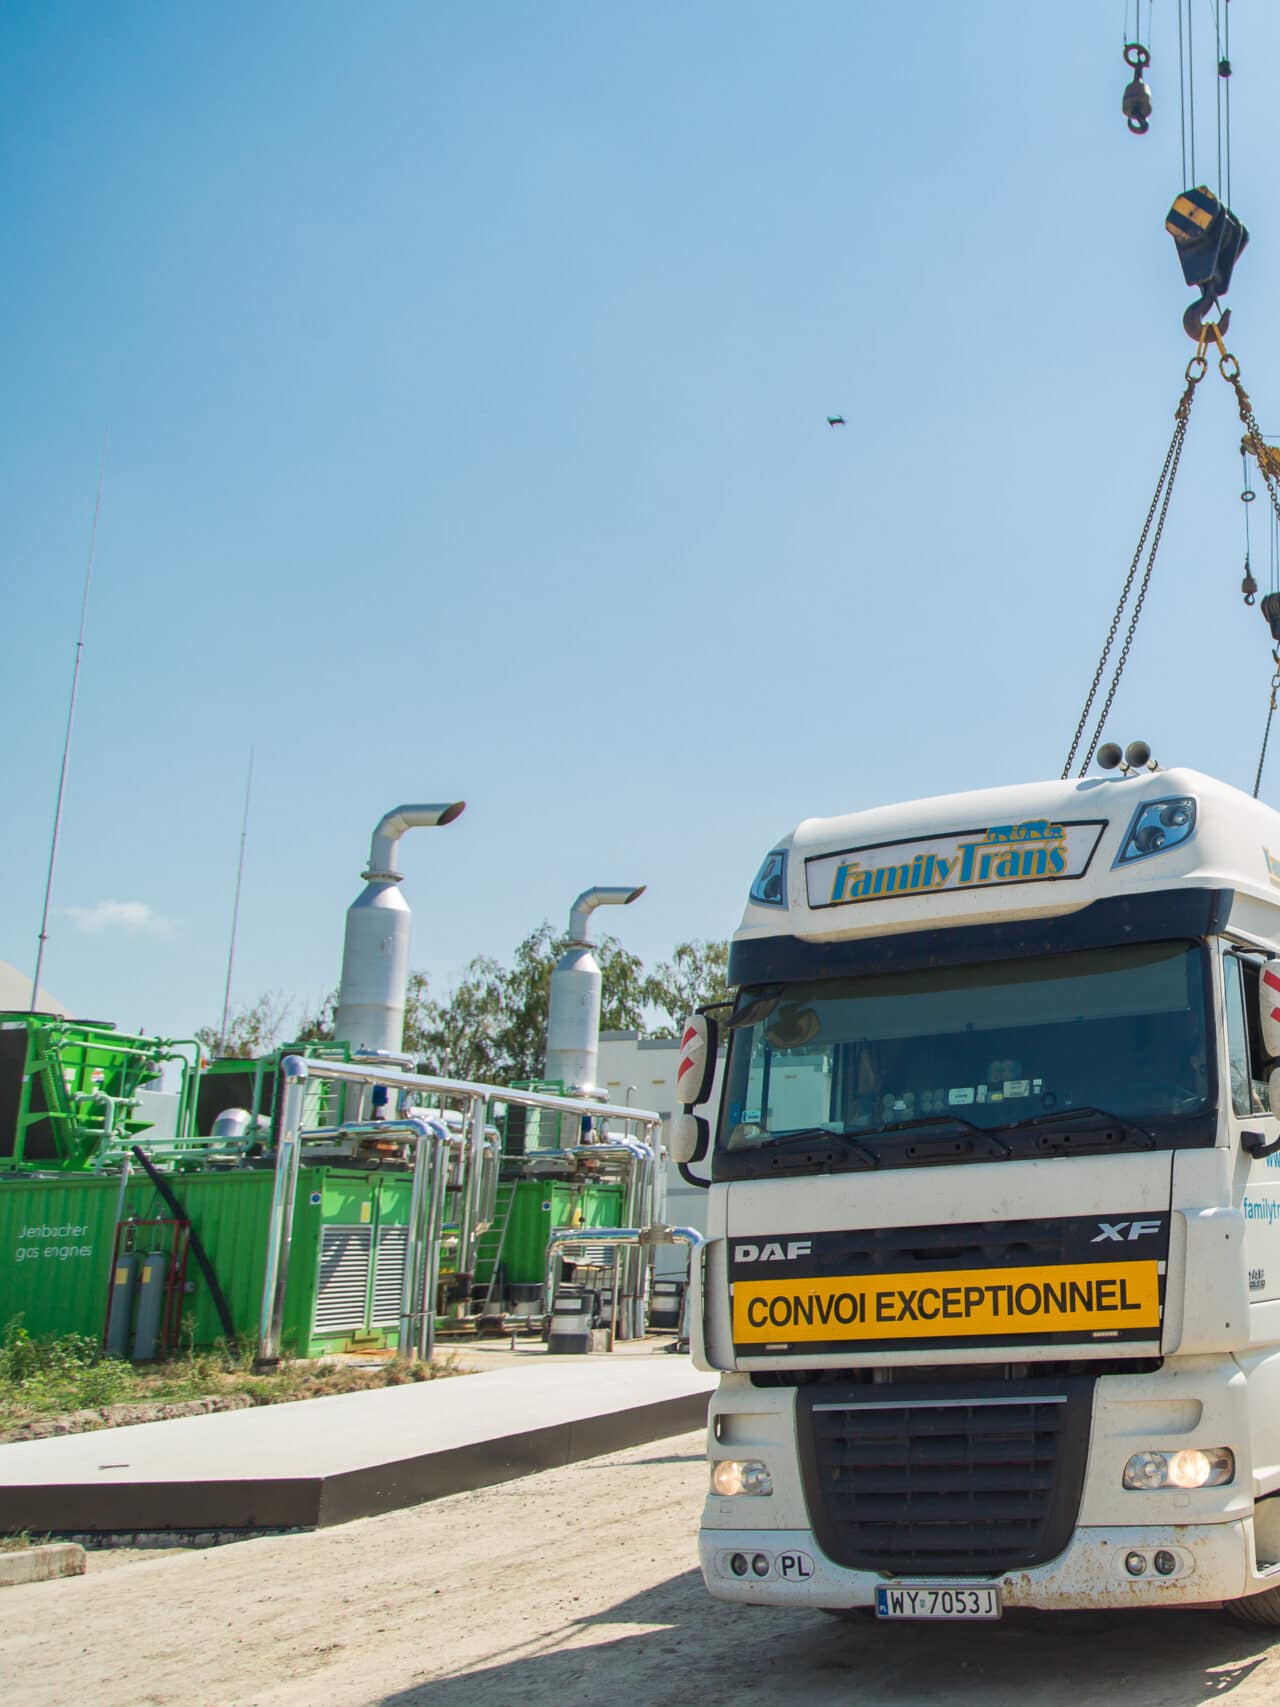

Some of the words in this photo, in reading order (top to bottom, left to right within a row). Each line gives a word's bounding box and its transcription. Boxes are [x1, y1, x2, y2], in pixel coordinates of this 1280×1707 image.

[1090, 1220, 1162, 1243] XF
[734, 1241, 813, 1263] DAF
[747, 1291, 867, 1328] CONVOI
[875, 1279, 1142, 1322] EXCEPTIONNEL
[781, 1555, 810, 1577] PL
[889, 1591, 920, 1614] WY
[927, 1591, 993, 1614] 7053J
